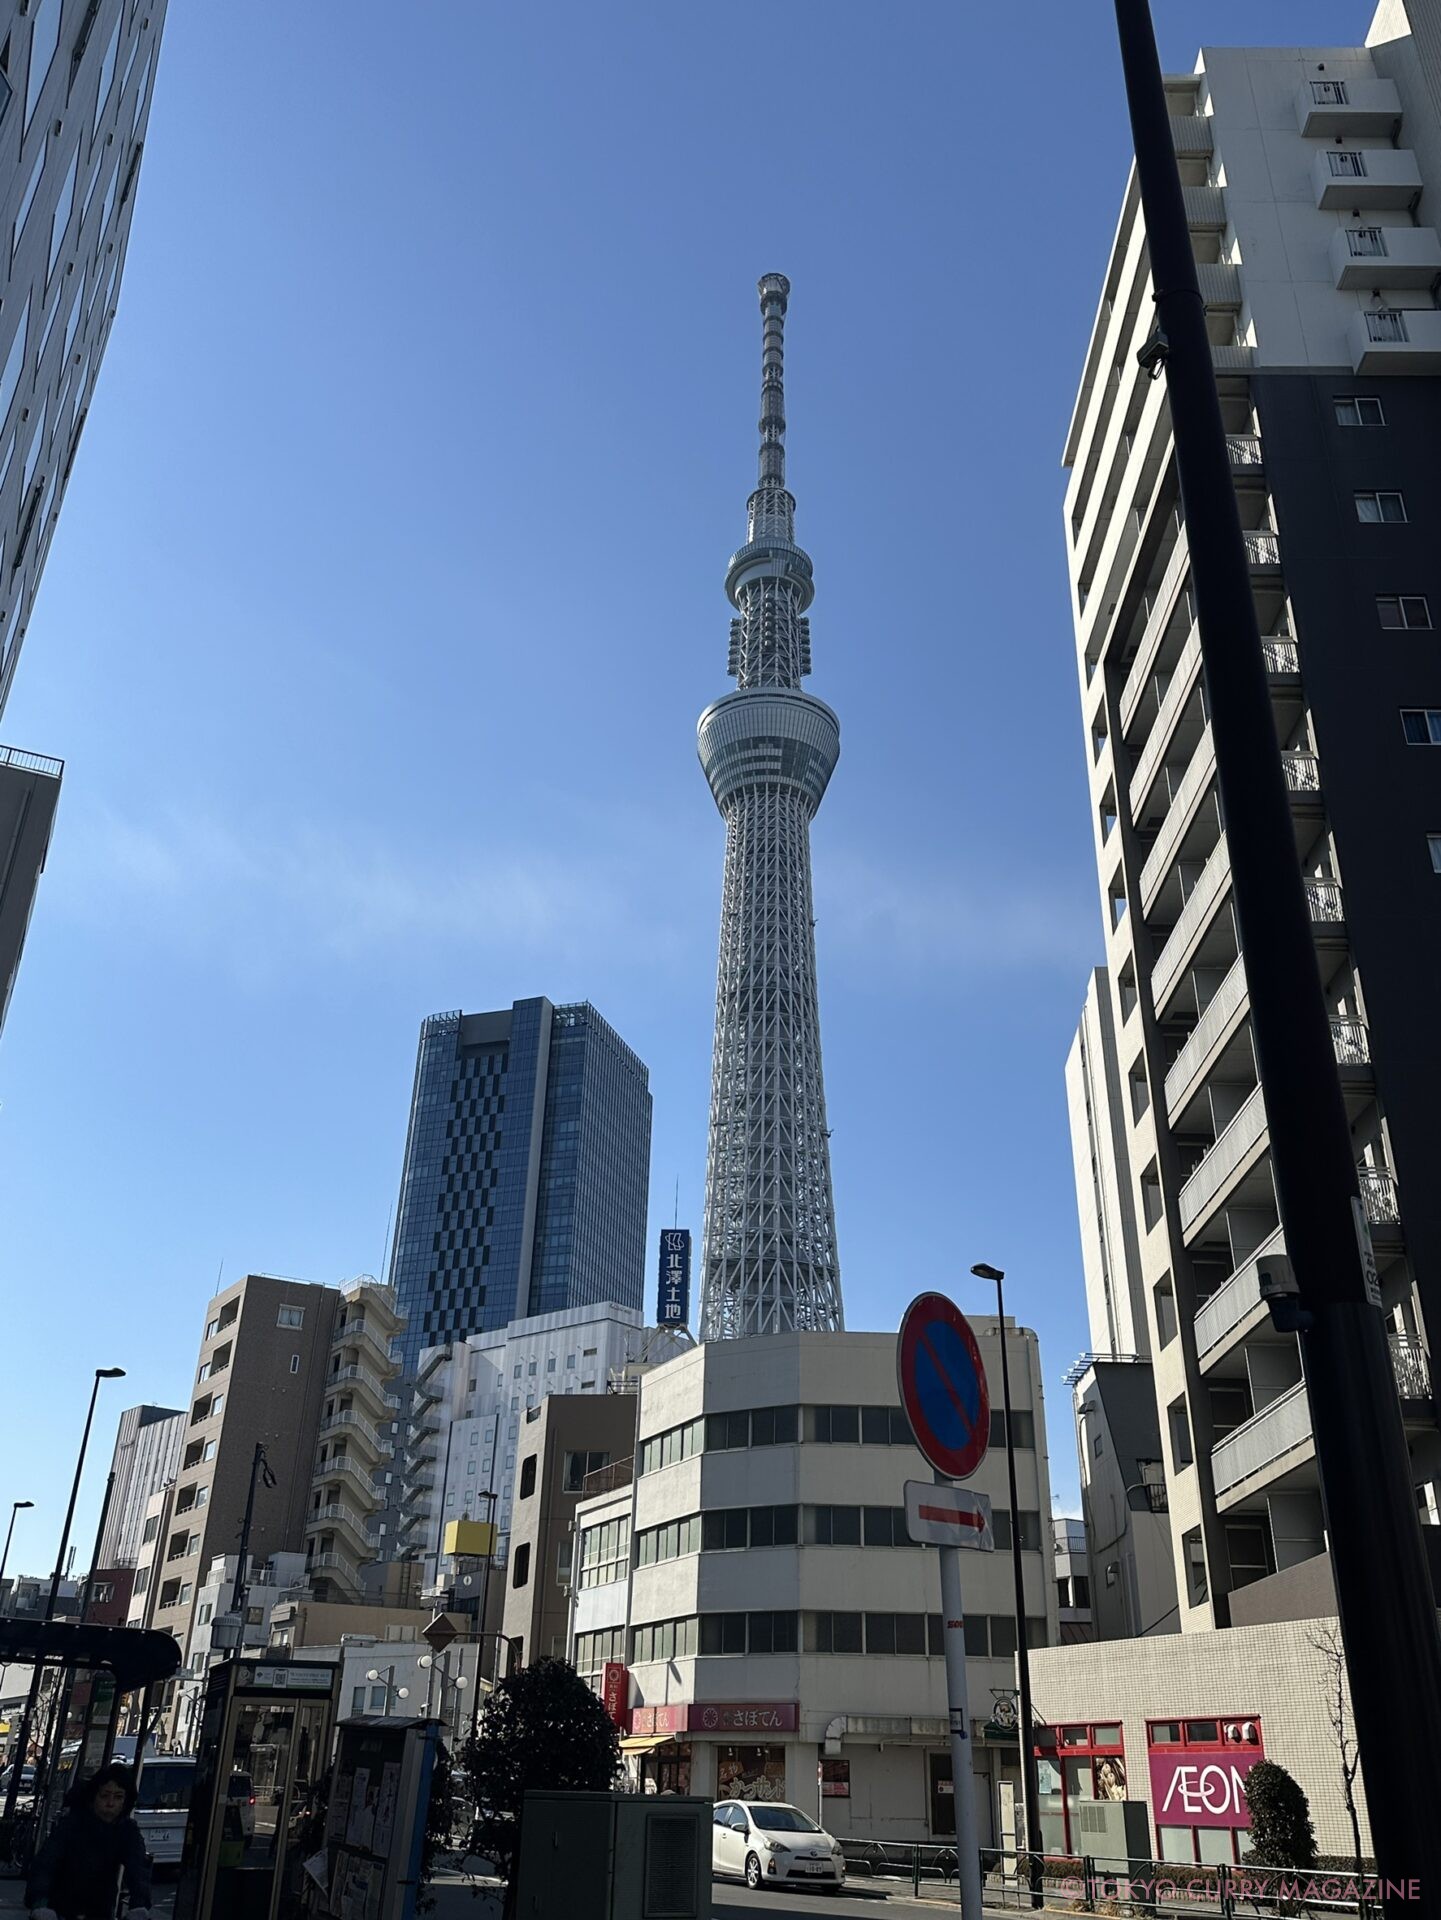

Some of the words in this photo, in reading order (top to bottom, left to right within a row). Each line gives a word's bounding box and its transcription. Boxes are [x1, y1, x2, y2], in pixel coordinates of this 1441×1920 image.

[665, 1253, 683, 1319] 北澤土地
[733, 1709, 784, 1727] さぼてん
